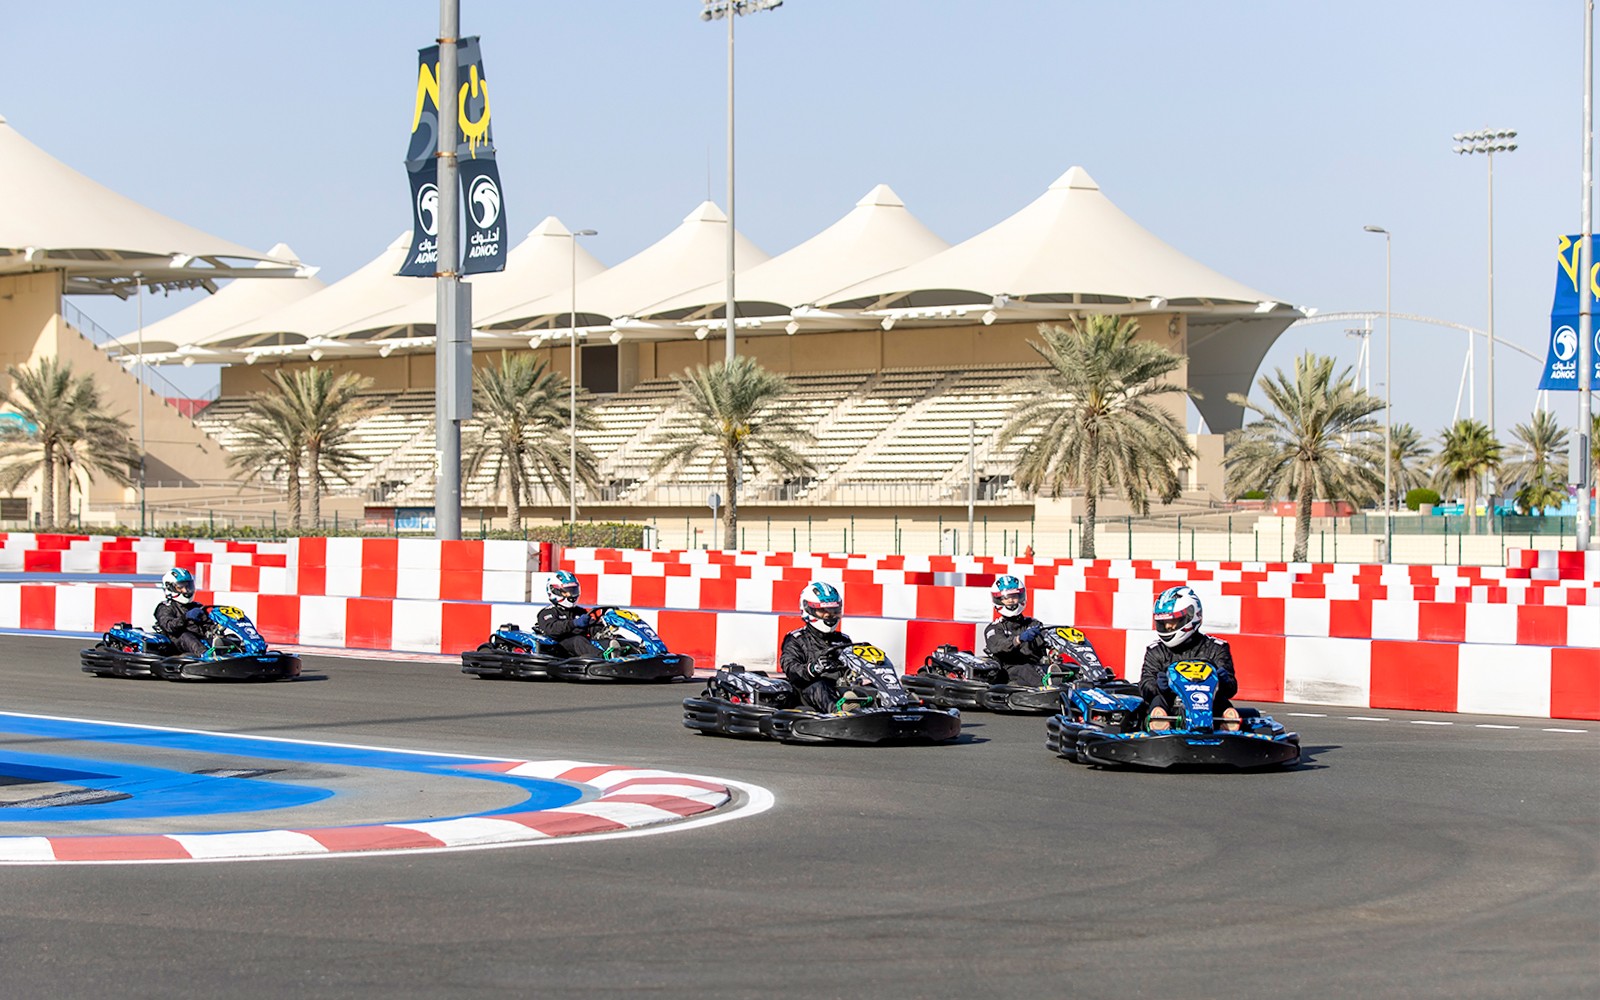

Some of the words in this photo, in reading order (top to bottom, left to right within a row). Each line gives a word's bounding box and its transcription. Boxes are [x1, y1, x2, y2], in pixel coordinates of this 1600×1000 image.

[469, 243, 499, 258] ADNOC
[1550, 370, 1576, 379] ADNOC
[1057, 629, 1083, 638] 14
[853, 647, 882, 657] 20
[1178, 663, 1207, 672] 27
